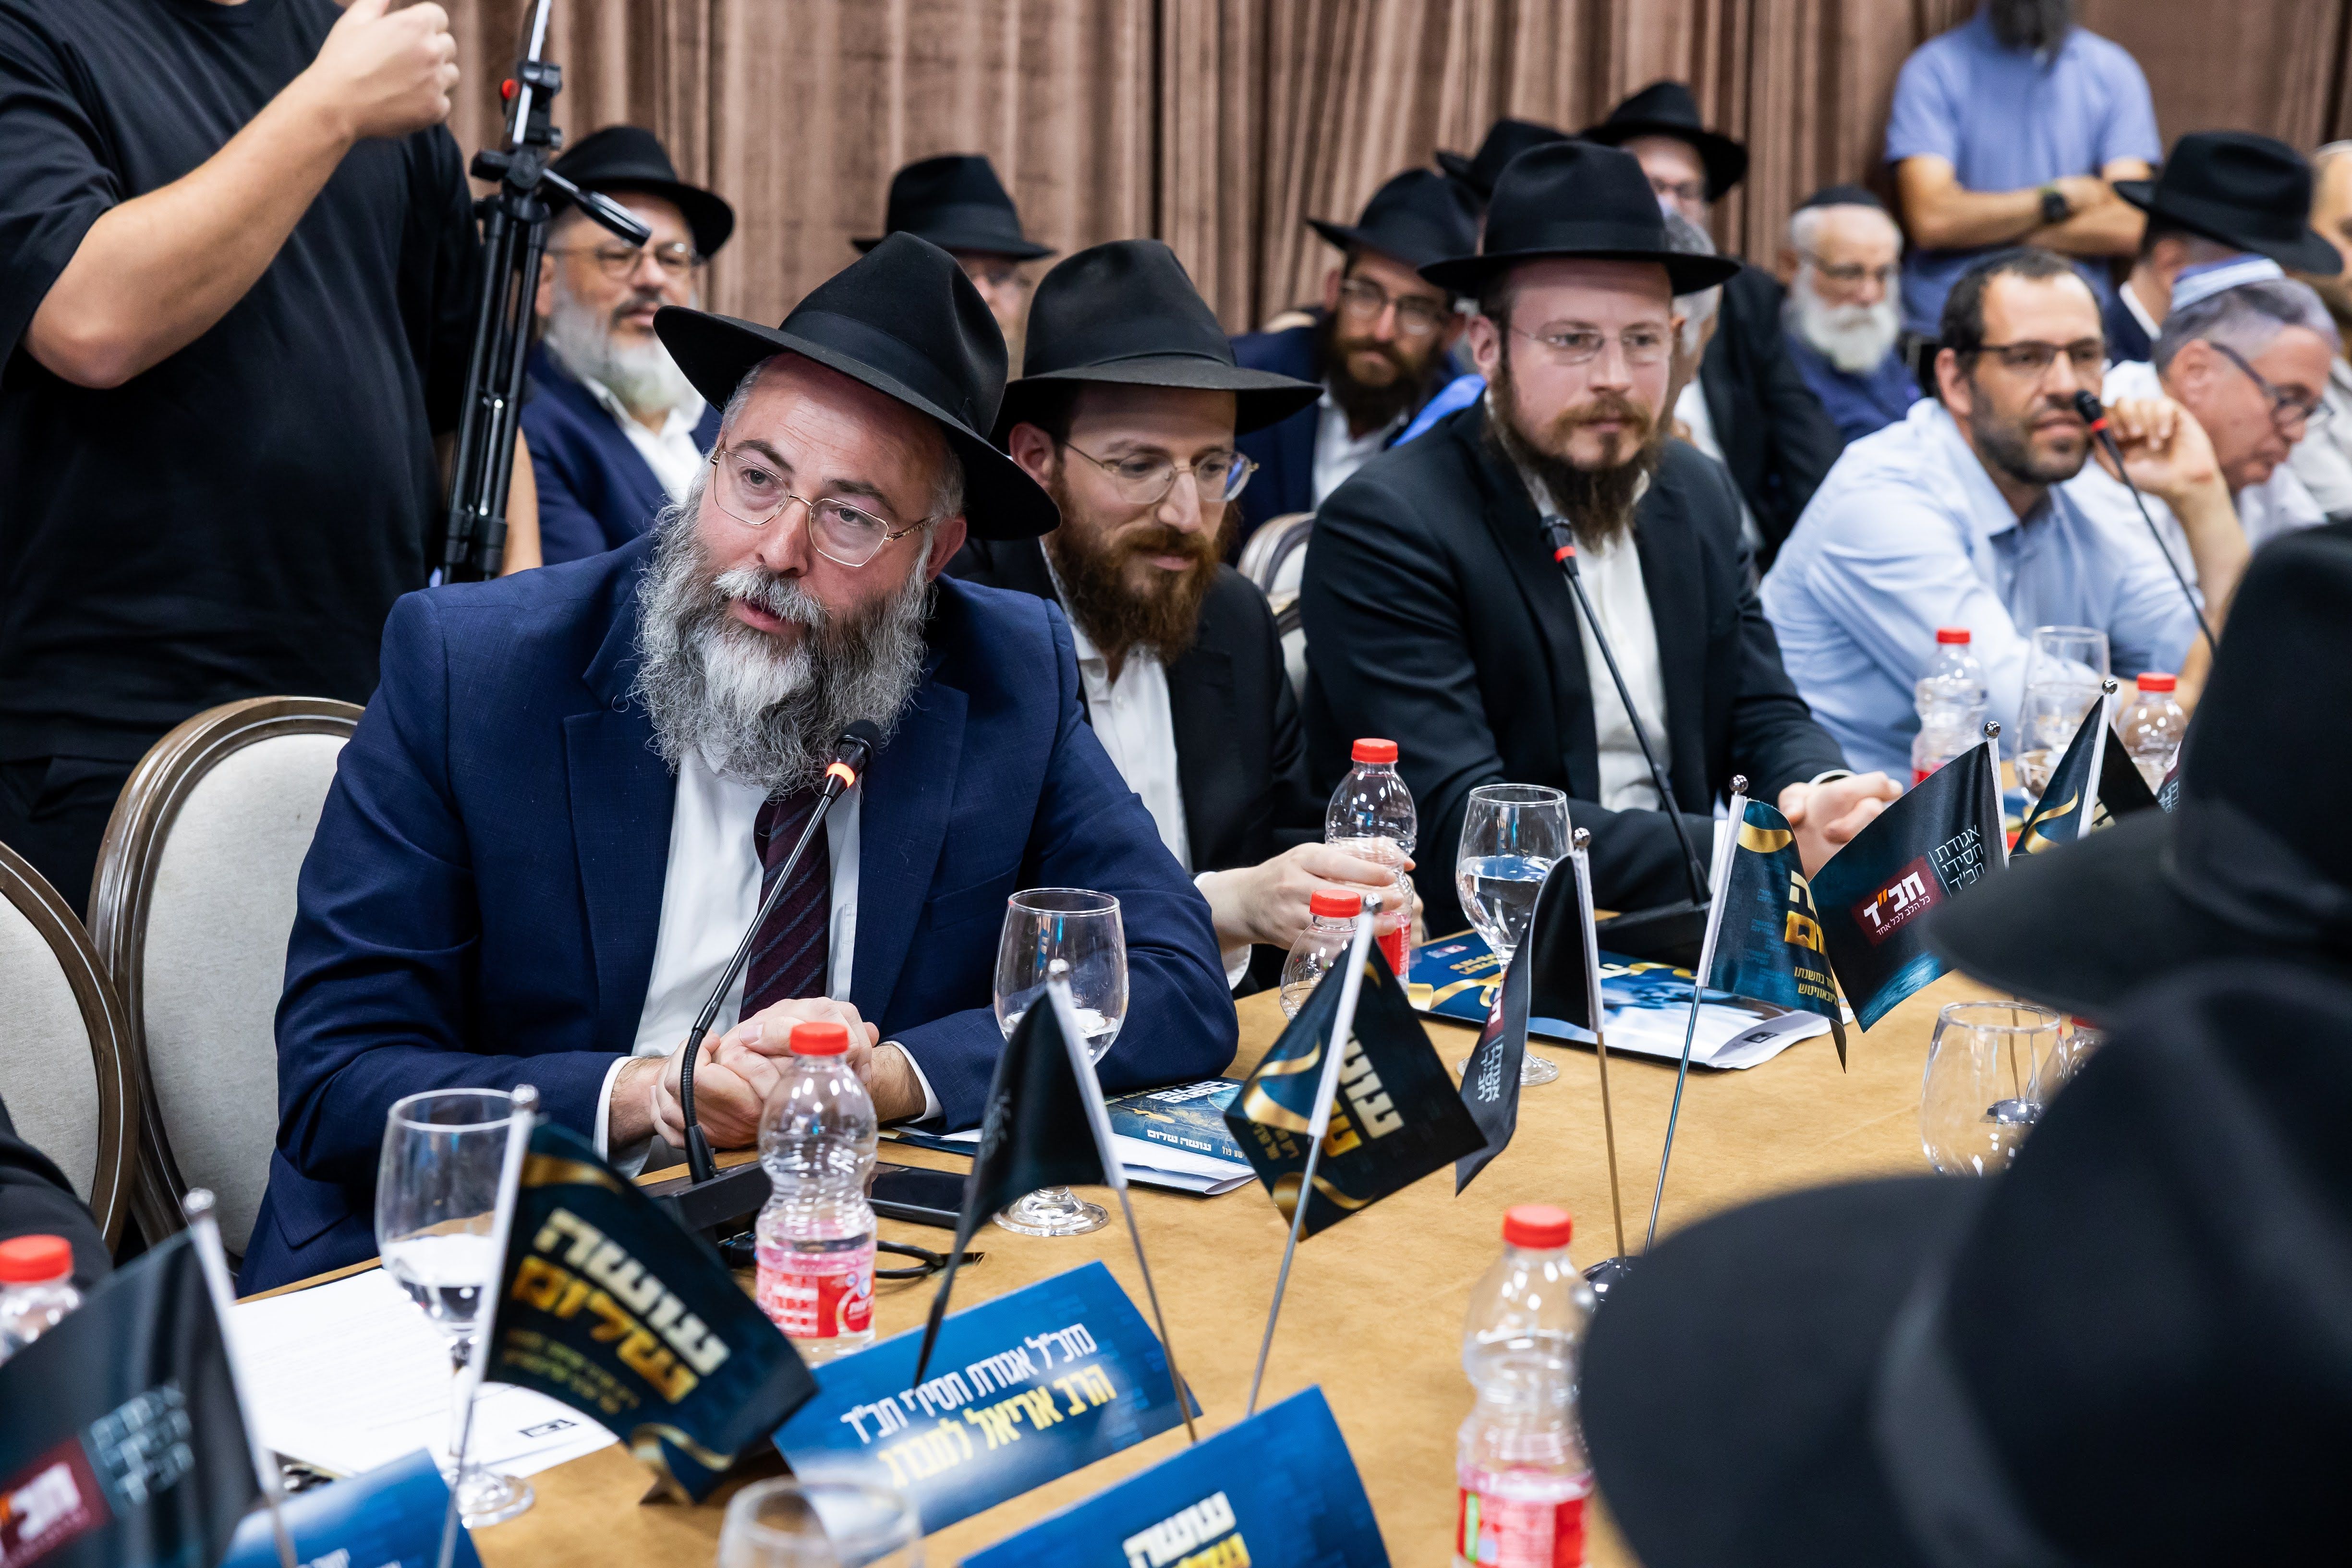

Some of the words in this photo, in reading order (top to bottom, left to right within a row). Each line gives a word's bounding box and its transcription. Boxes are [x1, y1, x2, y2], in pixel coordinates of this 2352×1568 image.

[1935, 825, 1980, 863] אגודת
[1941, 843, 1983, 872] חסידי
[1949, 862, 1985, 890] חב"ד
[1863, 871, 1926, 927] חב"ד
[1904, 902, 1920, 916] הלב
[1919, 895, 1931, 905] כל
[1876, 923, 1891, 936] אחד
[1890, 912, 1904, 926] לכל
[1794, 966, 1824, 984] במשנתו
[1146, 1129, 1178, 1144] שלום
[1179, 1137, 1212, 1152] עושה
[533, 1206, 731, 1376] עושה
[510, 1254, 699, 1405] שלום
[1024, 1323, 1098, 1370] מזכ"ל
[965, 1345, 1039, 1398] אגודת
[1053, 1363, 1117, 1418] הרב
[898, 1371, 975, 1417] חסידי
[840, 1397, 909, 1444] חב"ד
[962, 1385, 1065, 1450] אריאל
